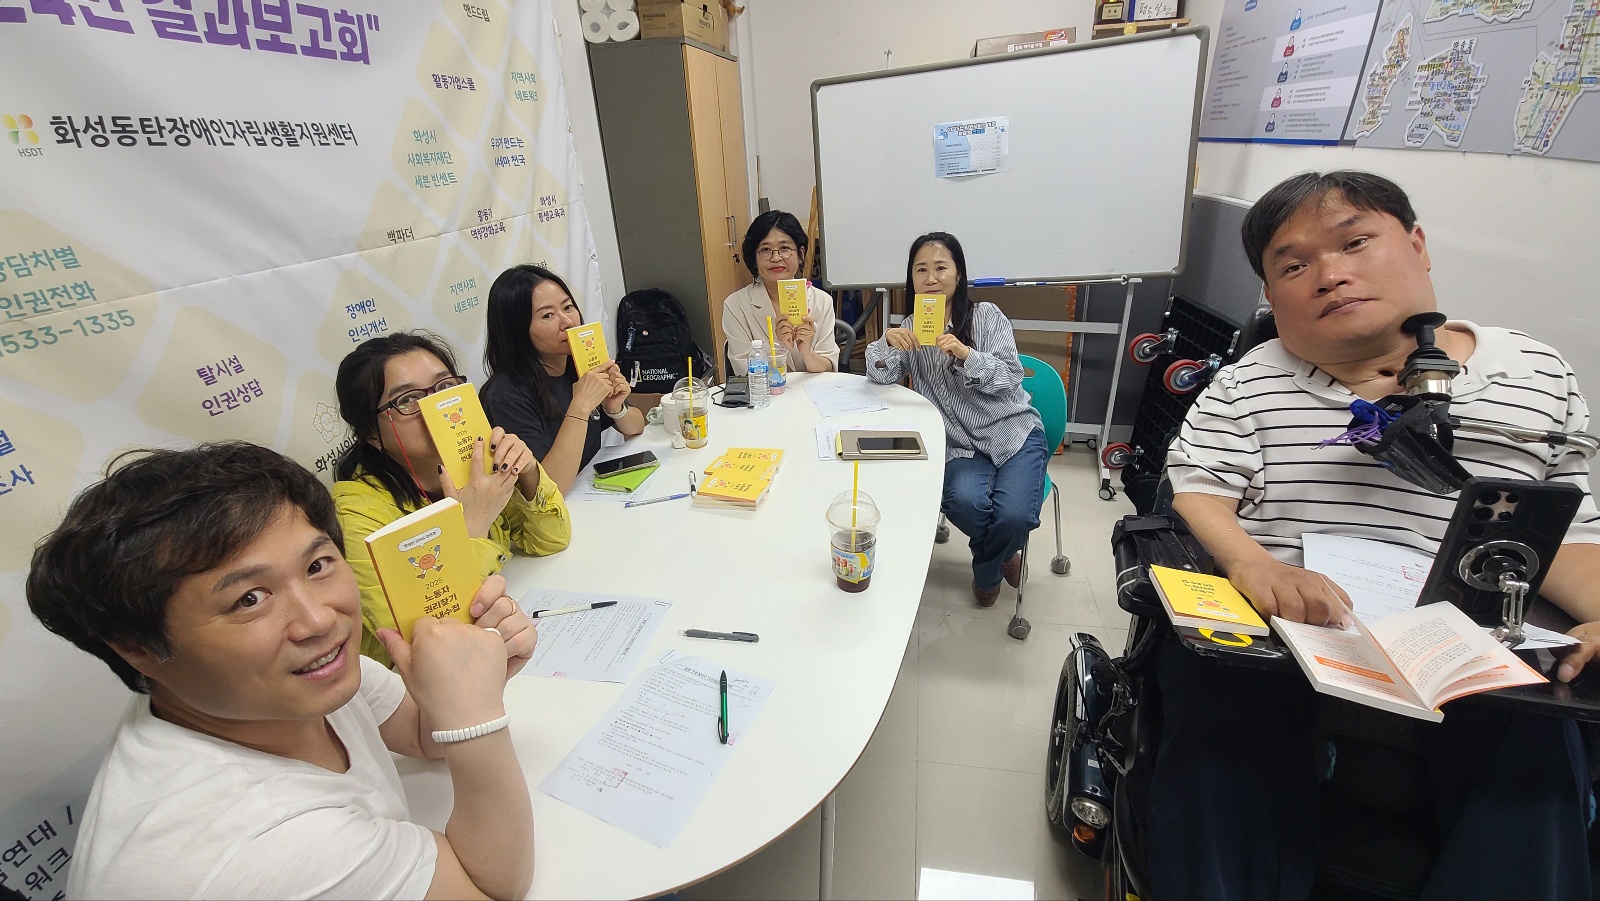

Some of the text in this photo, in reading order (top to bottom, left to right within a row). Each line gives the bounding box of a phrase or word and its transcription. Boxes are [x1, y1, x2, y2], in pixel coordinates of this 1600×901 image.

[462, 3, 491, 23] 핸드드립
[431, 73, 477, 91] 활동가업스쿨
[511, 71, 537, 85] 지역사회
[514, 90, 539, 102] 네트워크
[50, 115, 358, 148] 화성동탄장애인자립생활지원센터
[412, 129, 437, 145] 화성시
[504, 136, 525, 149] 만드는
[18, 147, 43, 158] HSDT
[407, 151, 454, 166] 사회복지재단
[511, 154, 526, 167] 천국
[414, 172, 459, 189] 세븐 빈센트
[539, 194, 557, 206] 화성시
[477, 207, 493, 223] 활동가
[386, 226, 415, 244] 백파더
[450, 277, 477, 296] 지역사회
[0, 280, 98, 319] 인권전화
[454, 296, 480, 314] 네트워크
[345, 298, 377, 319] 장애인
[0, 308, 136, 357] 533-1335
[348, 317, 389, 343] 인식개선
[196, 354, 245, 387] 탈시설
[201, 378, 264, 417] 인권상담
[457, 435, 473, 447] 노동자
[425, 578, 444, 590] 2025
[425, 585, 451, 602] 노동자
[424, 593, 458, 614] 권리찾기
[431, 603, 461, 620] 내수첩
